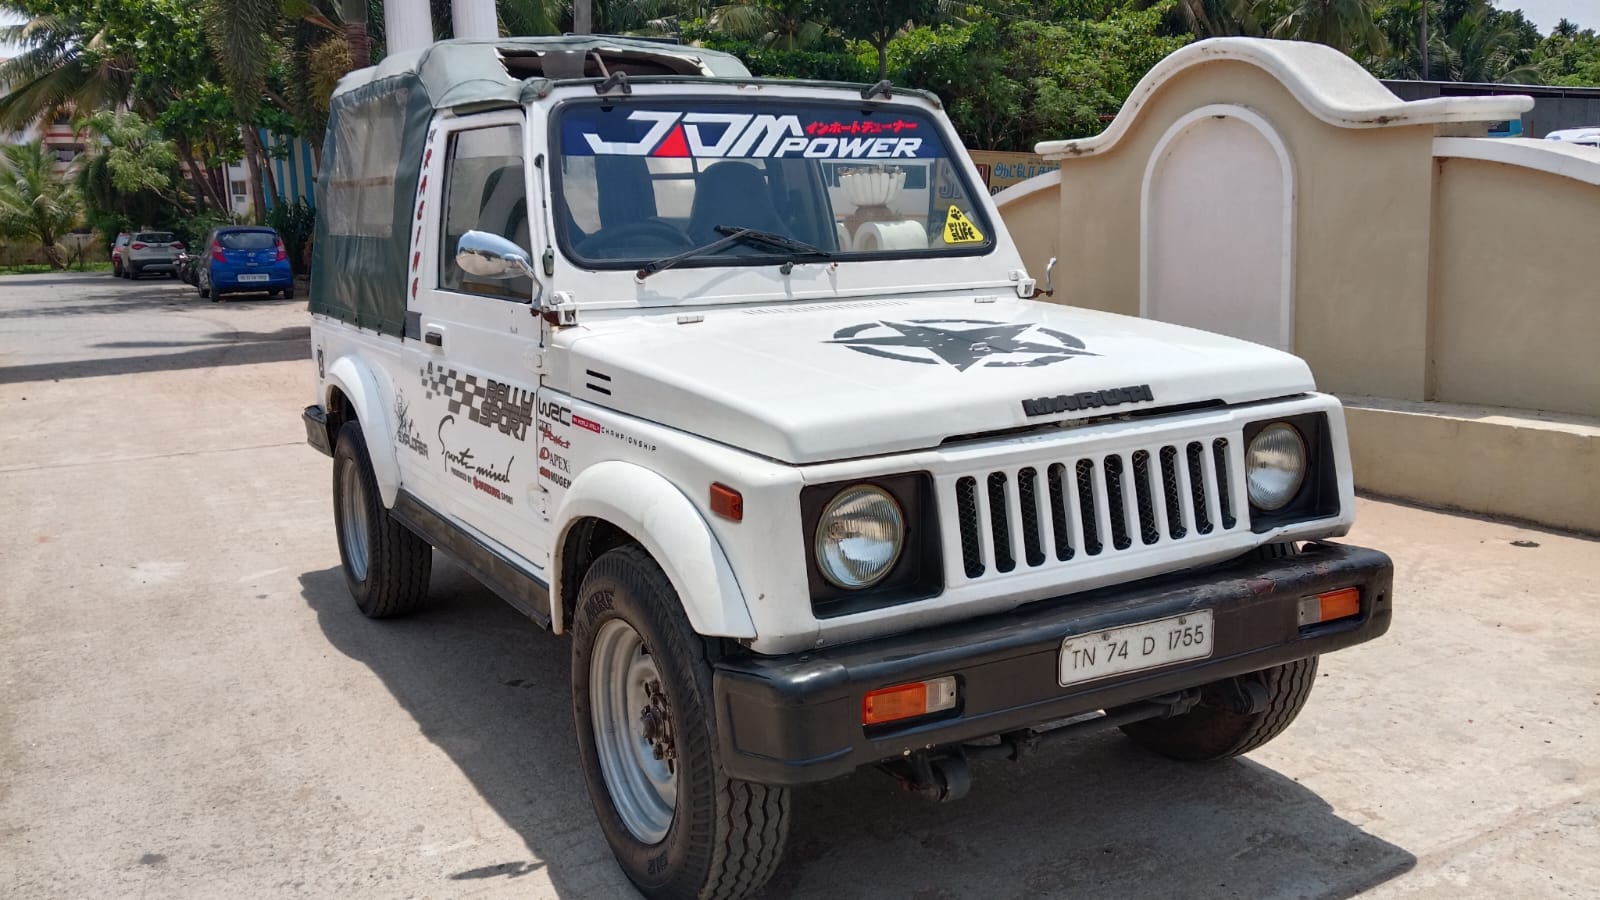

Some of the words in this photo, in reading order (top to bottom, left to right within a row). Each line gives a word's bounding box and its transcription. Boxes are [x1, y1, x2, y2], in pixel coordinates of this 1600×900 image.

[775, 137, 922, 158] POWER
[486, 378, 535, 417] RALLY
[1021, 384, 1154, 417] MARUTI
[479, 401, 533, 441] SPORT
[538, 396, 571, 427] WRC
[601, 426, 657, 452] CHAMPIONSHIP
[1072, 648, 1096, 669] TN
[1107, 640, 1129, 663] 74
[1142, 637, 1155, 656] D
[1168, 624, 1204, 651] 1755
